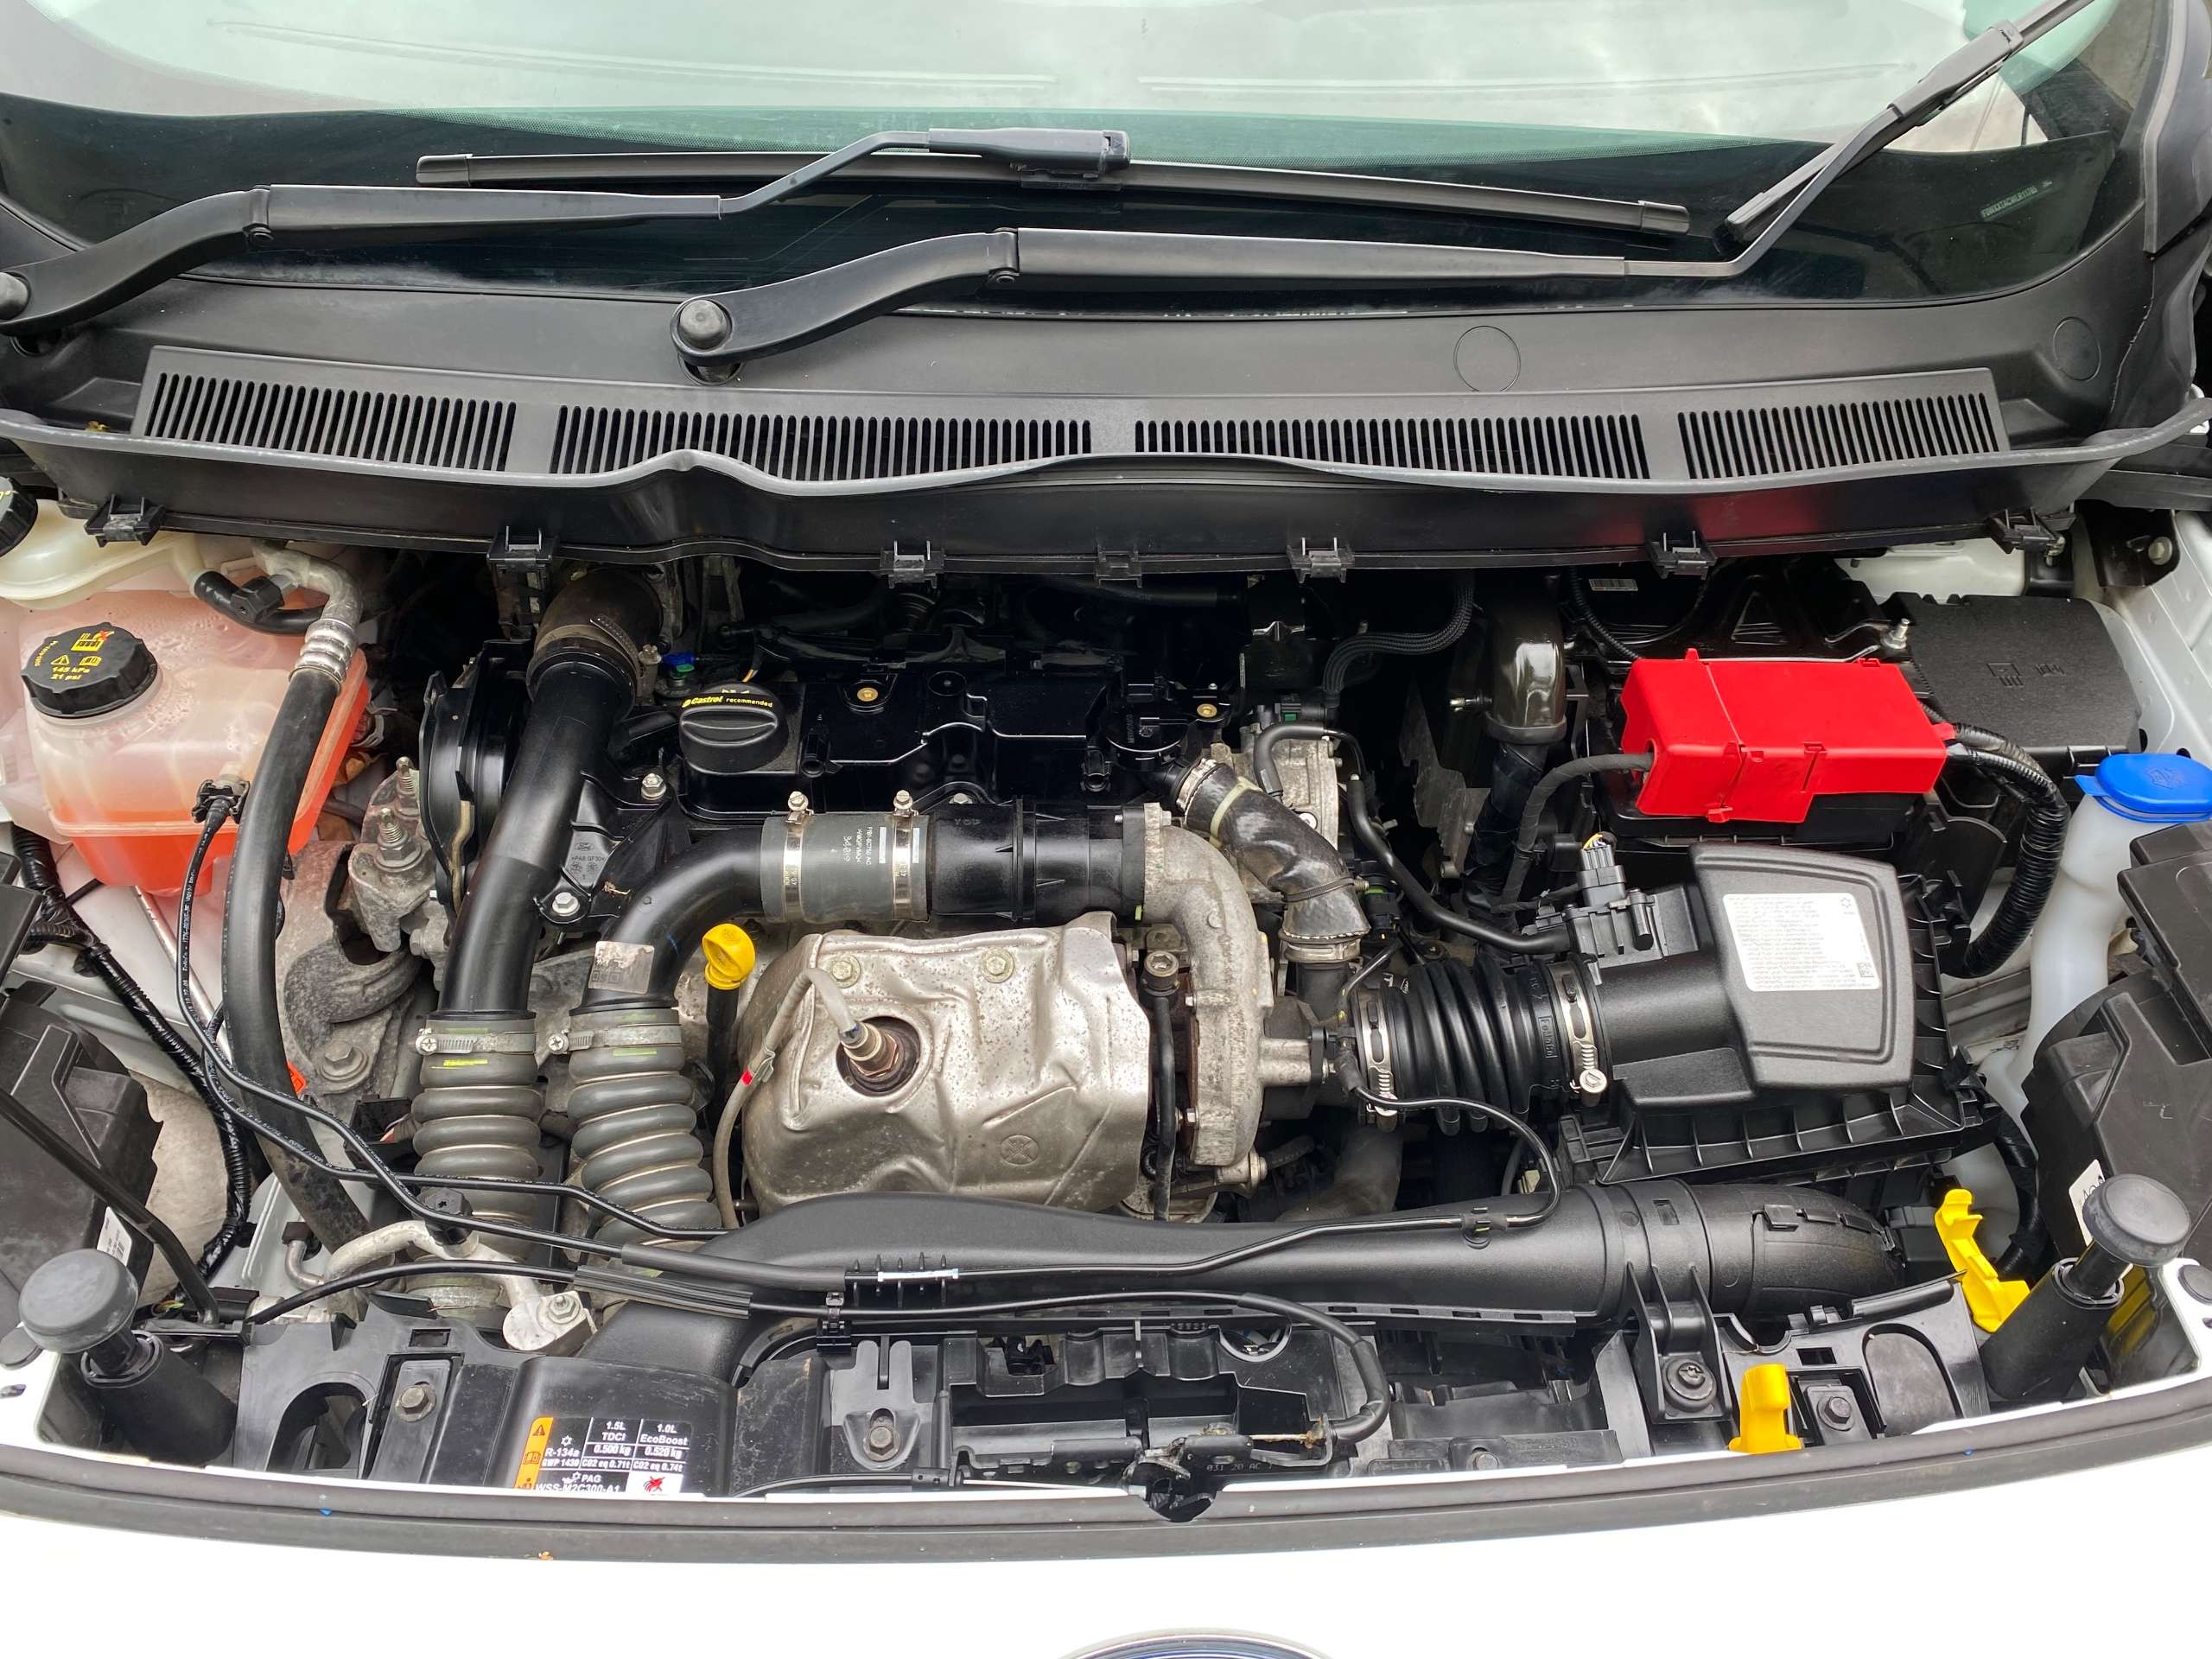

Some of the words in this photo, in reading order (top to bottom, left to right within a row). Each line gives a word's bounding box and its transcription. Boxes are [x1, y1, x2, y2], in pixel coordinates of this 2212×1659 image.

[691, 696, 724, 705] Castrol
[726, 697, 773, 708] recommended
[606, 1421, 626, 1431] 1.5L
[657, 1423, 678, 1433] 1.0L
[639, 1433, 689, 1446] EcoBoost
[544, 1447, 580, 1457] R-134a
[594, 1444, 619, 1454] 0.500
[620, 1446, 632, 1456] kg
[644, 1446, 670, 1458] 0.520
[671, 1447, 683, 1459] kg
[581, 1474, 602, 1483] PAG
[537, 1483, 620, 1492] WSS-M2C300-A1
